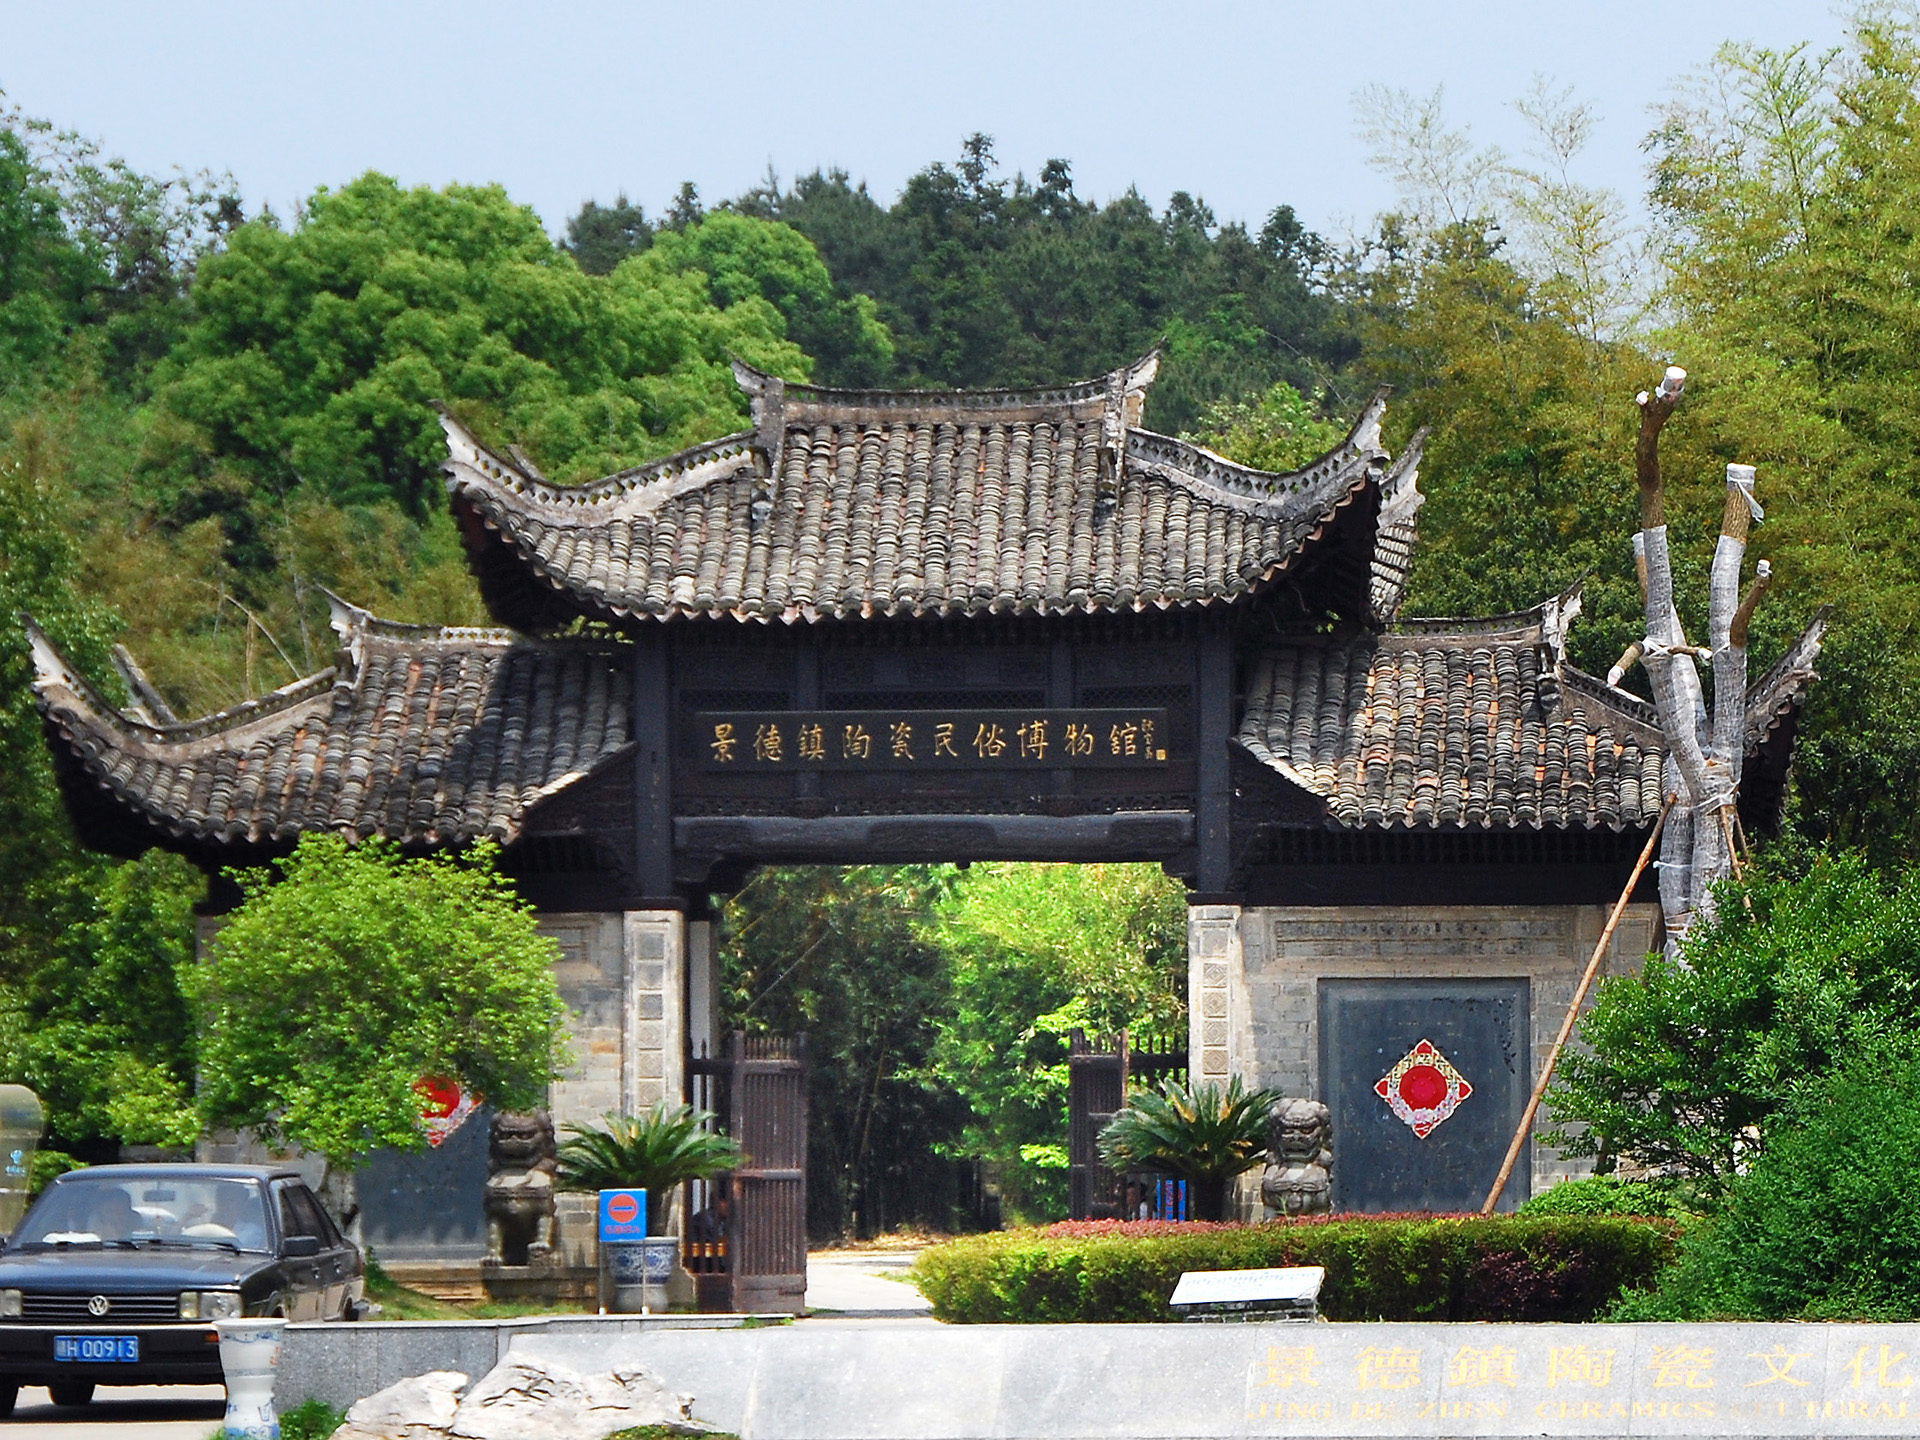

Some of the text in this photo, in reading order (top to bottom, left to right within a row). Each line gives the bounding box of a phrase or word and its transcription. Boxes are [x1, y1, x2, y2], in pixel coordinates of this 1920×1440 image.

[1247, 1401, 1332, 1419] JING
[1415, 1401, 1507, 1419] ZHEN
[1535, 1400, 1715, 1419] CERAMICS
